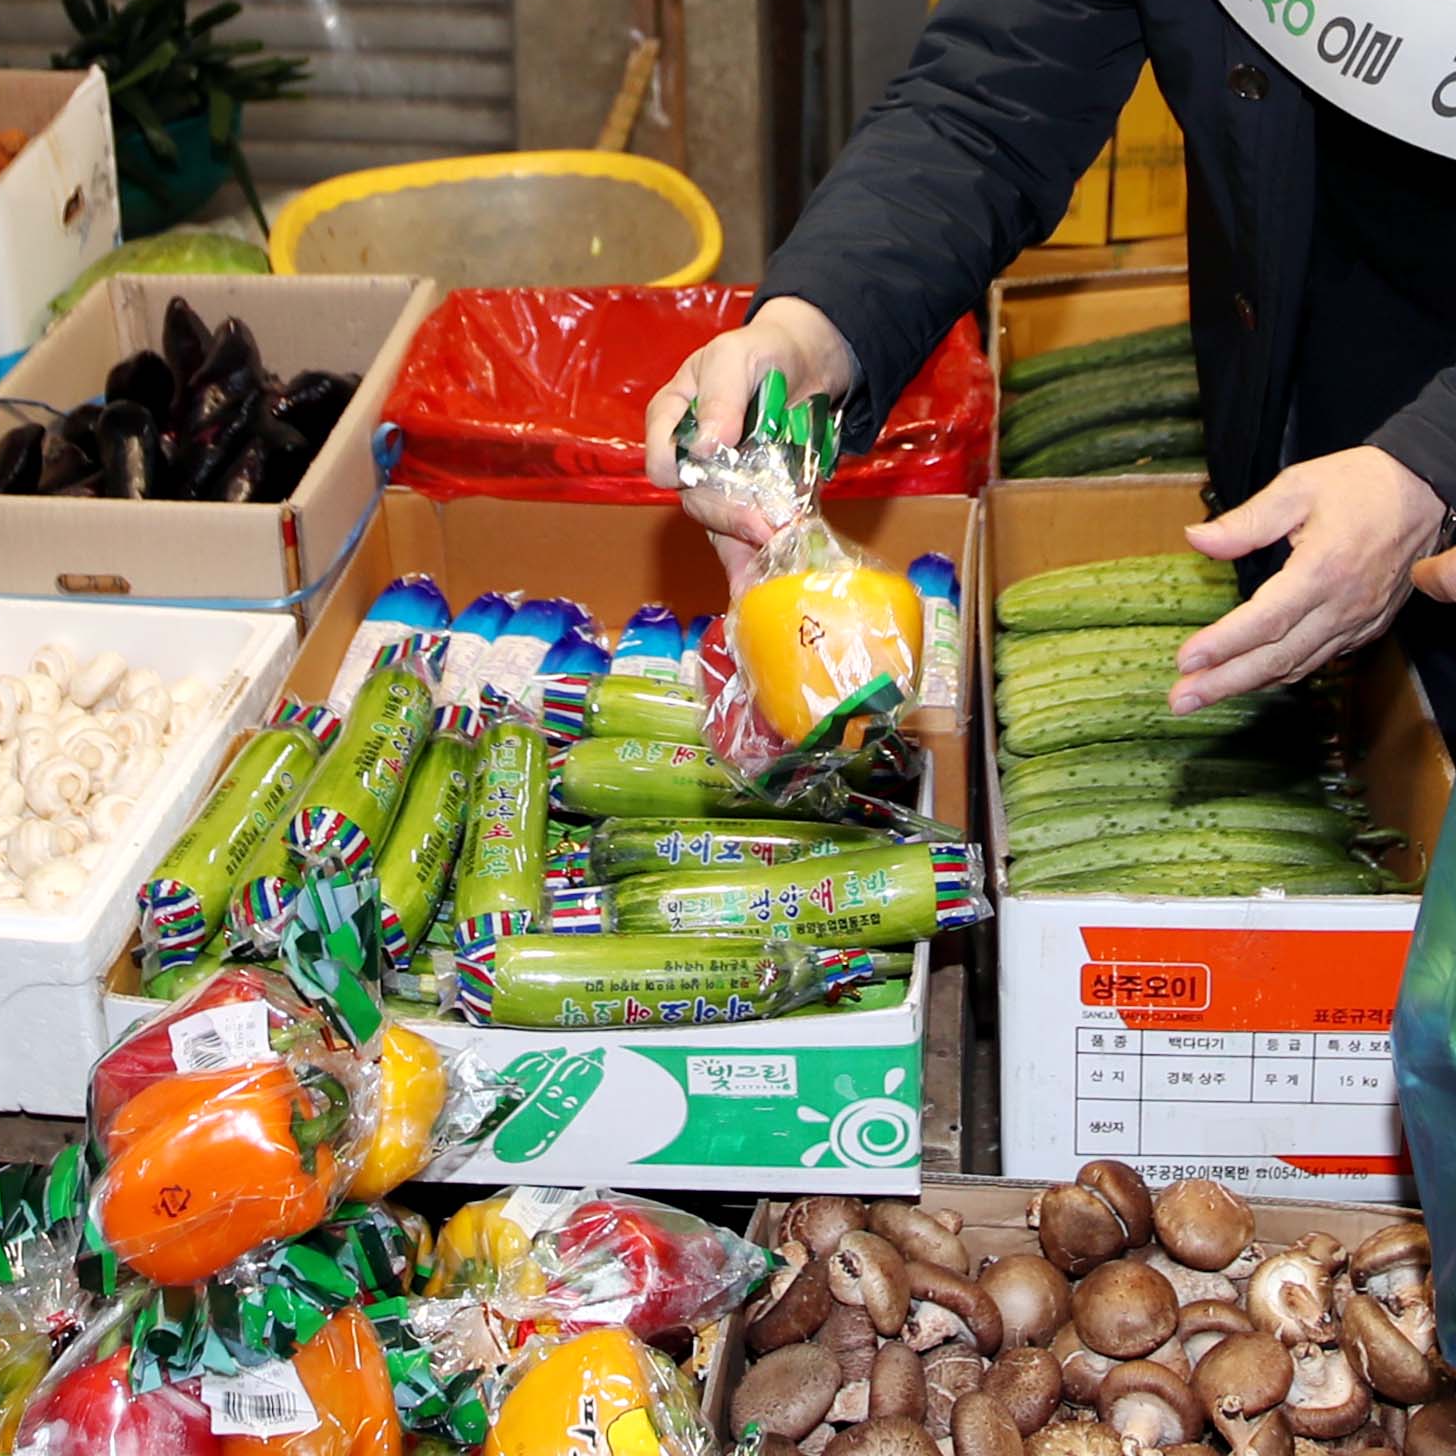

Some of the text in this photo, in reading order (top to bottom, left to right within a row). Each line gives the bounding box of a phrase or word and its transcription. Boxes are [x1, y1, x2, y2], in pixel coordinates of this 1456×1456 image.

[1092, 975, 1197, 1002] 상주오이
[555, 995, 754, 1026] 바이오애호박
[1168, 1037, 1224, 1050] 백다다기
[1167, 1071, 1226, 1085] 경북 상주
[1339, 1076, 1354, 1087] 15
[1089, 1121, 1125, 1134] 생산자
